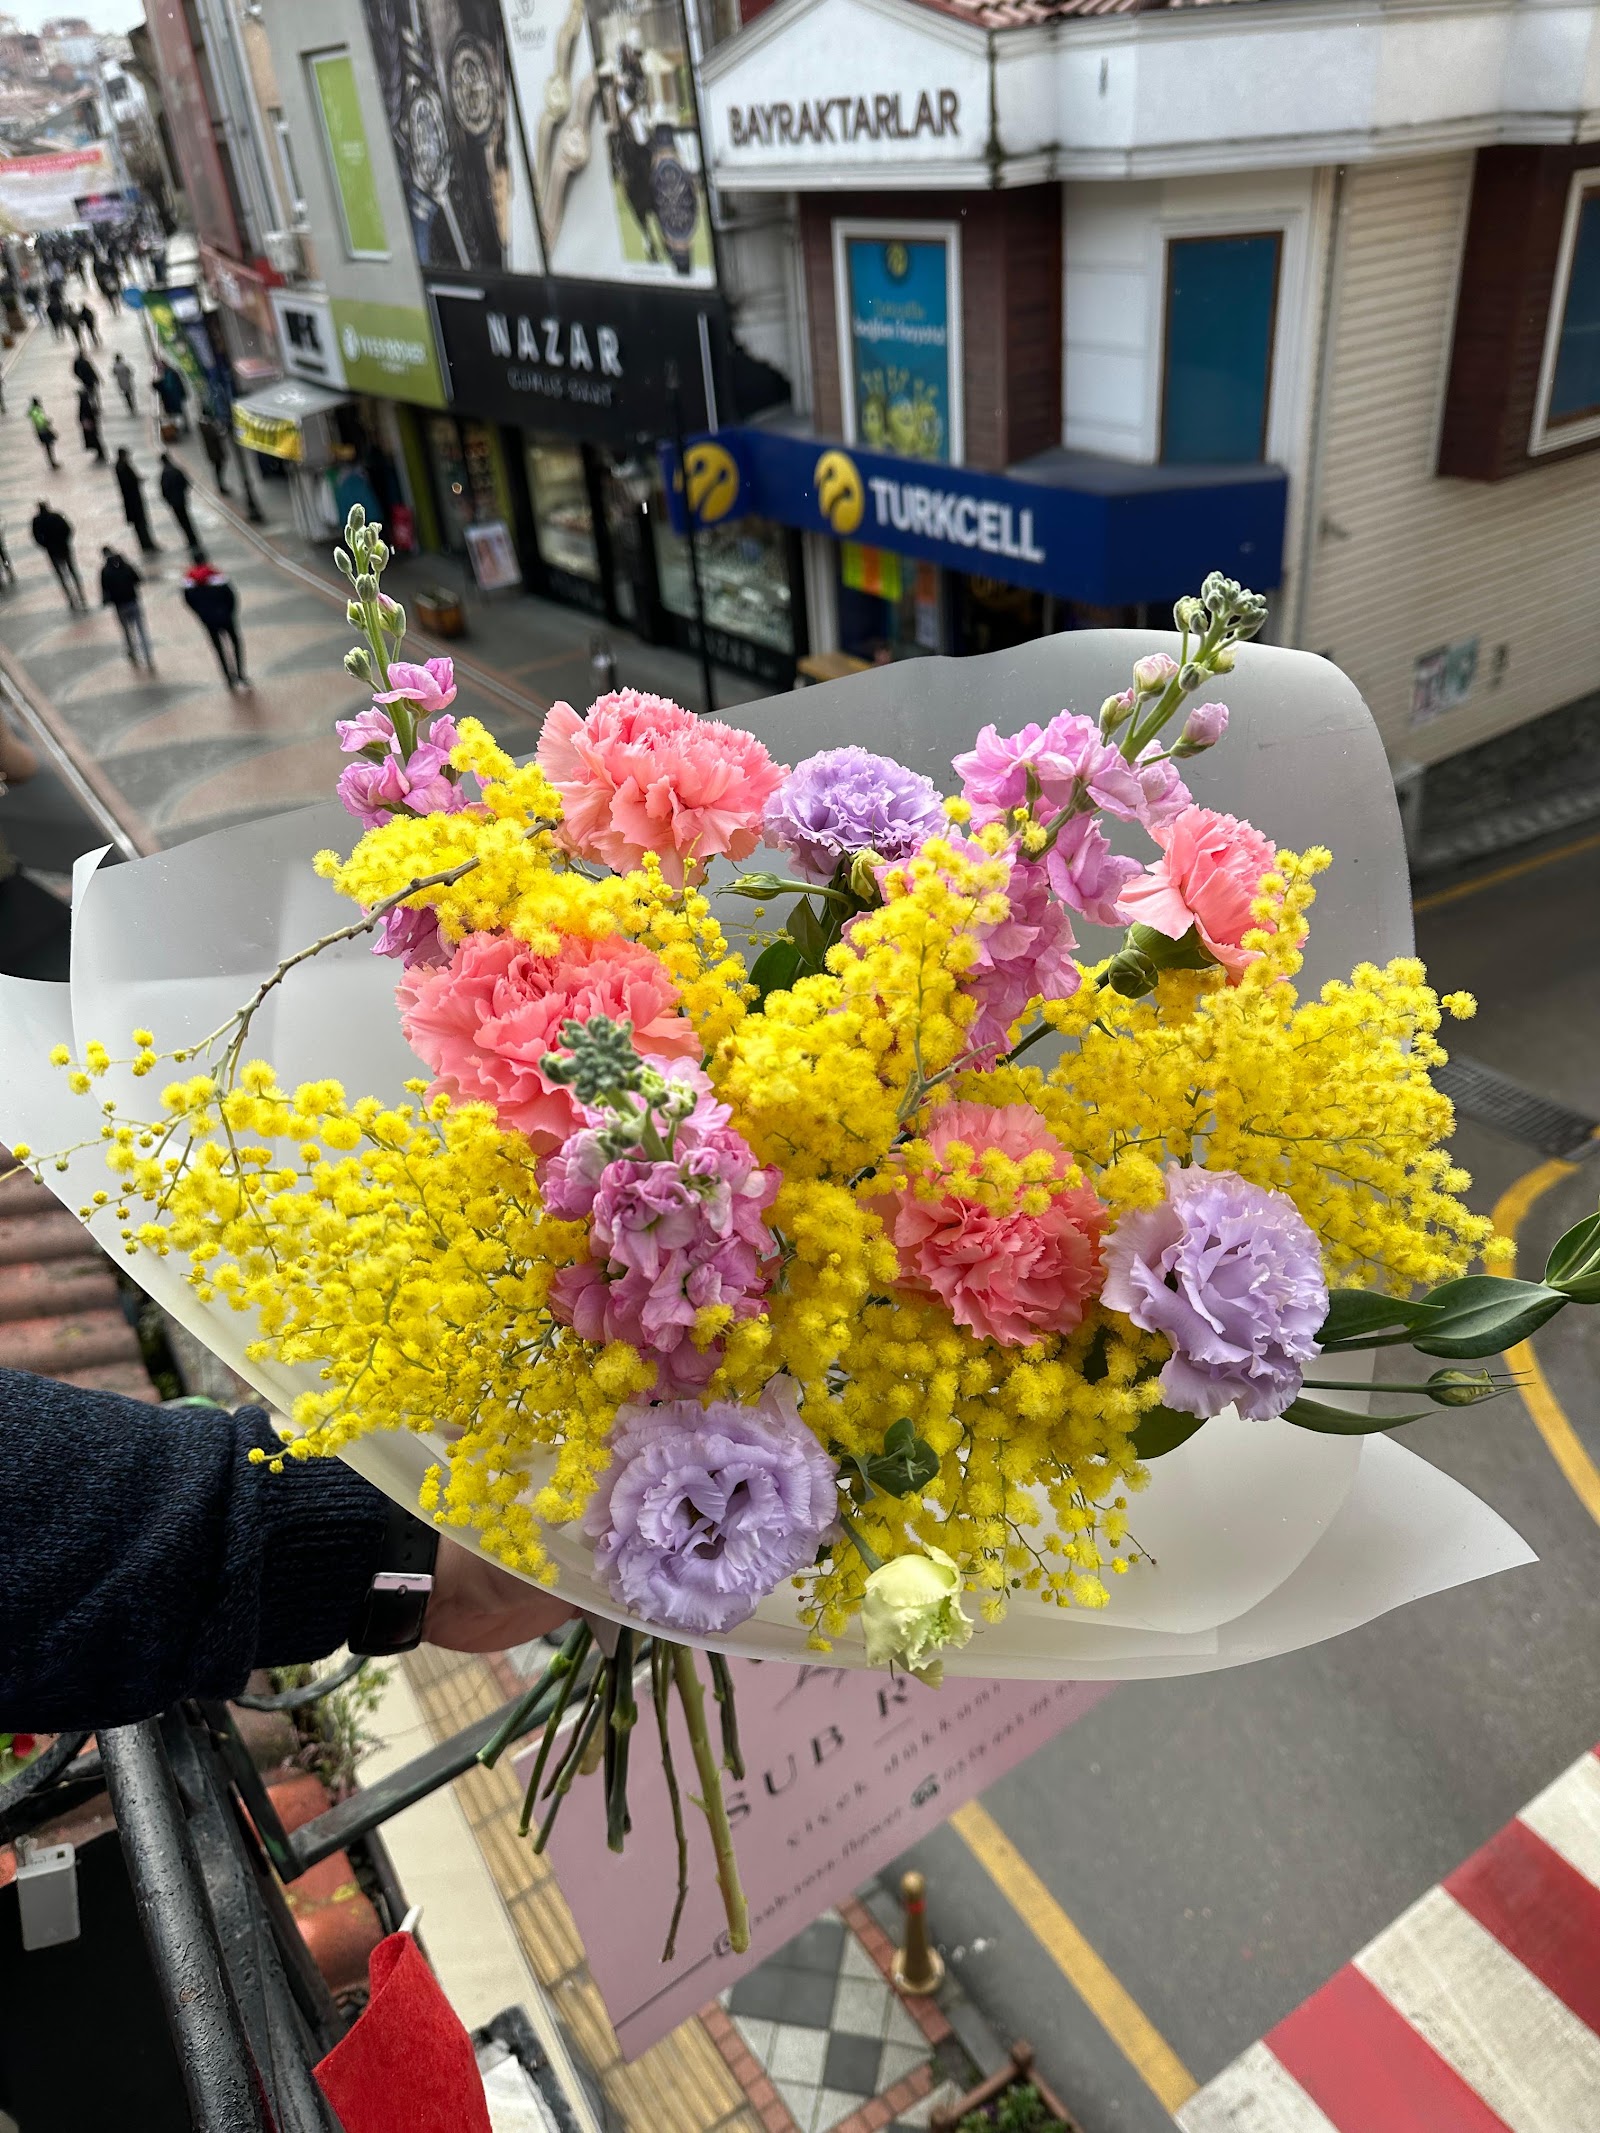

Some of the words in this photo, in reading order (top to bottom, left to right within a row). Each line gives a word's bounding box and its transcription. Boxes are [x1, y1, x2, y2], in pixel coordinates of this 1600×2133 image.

[728, 88, 960, 147] BAYRAKTARLAR
[486, 312, 624, 378] NAZAR
[868, 476, 1046, 565] TURKCELL
[725, 1724, 845, 1829] SUB
